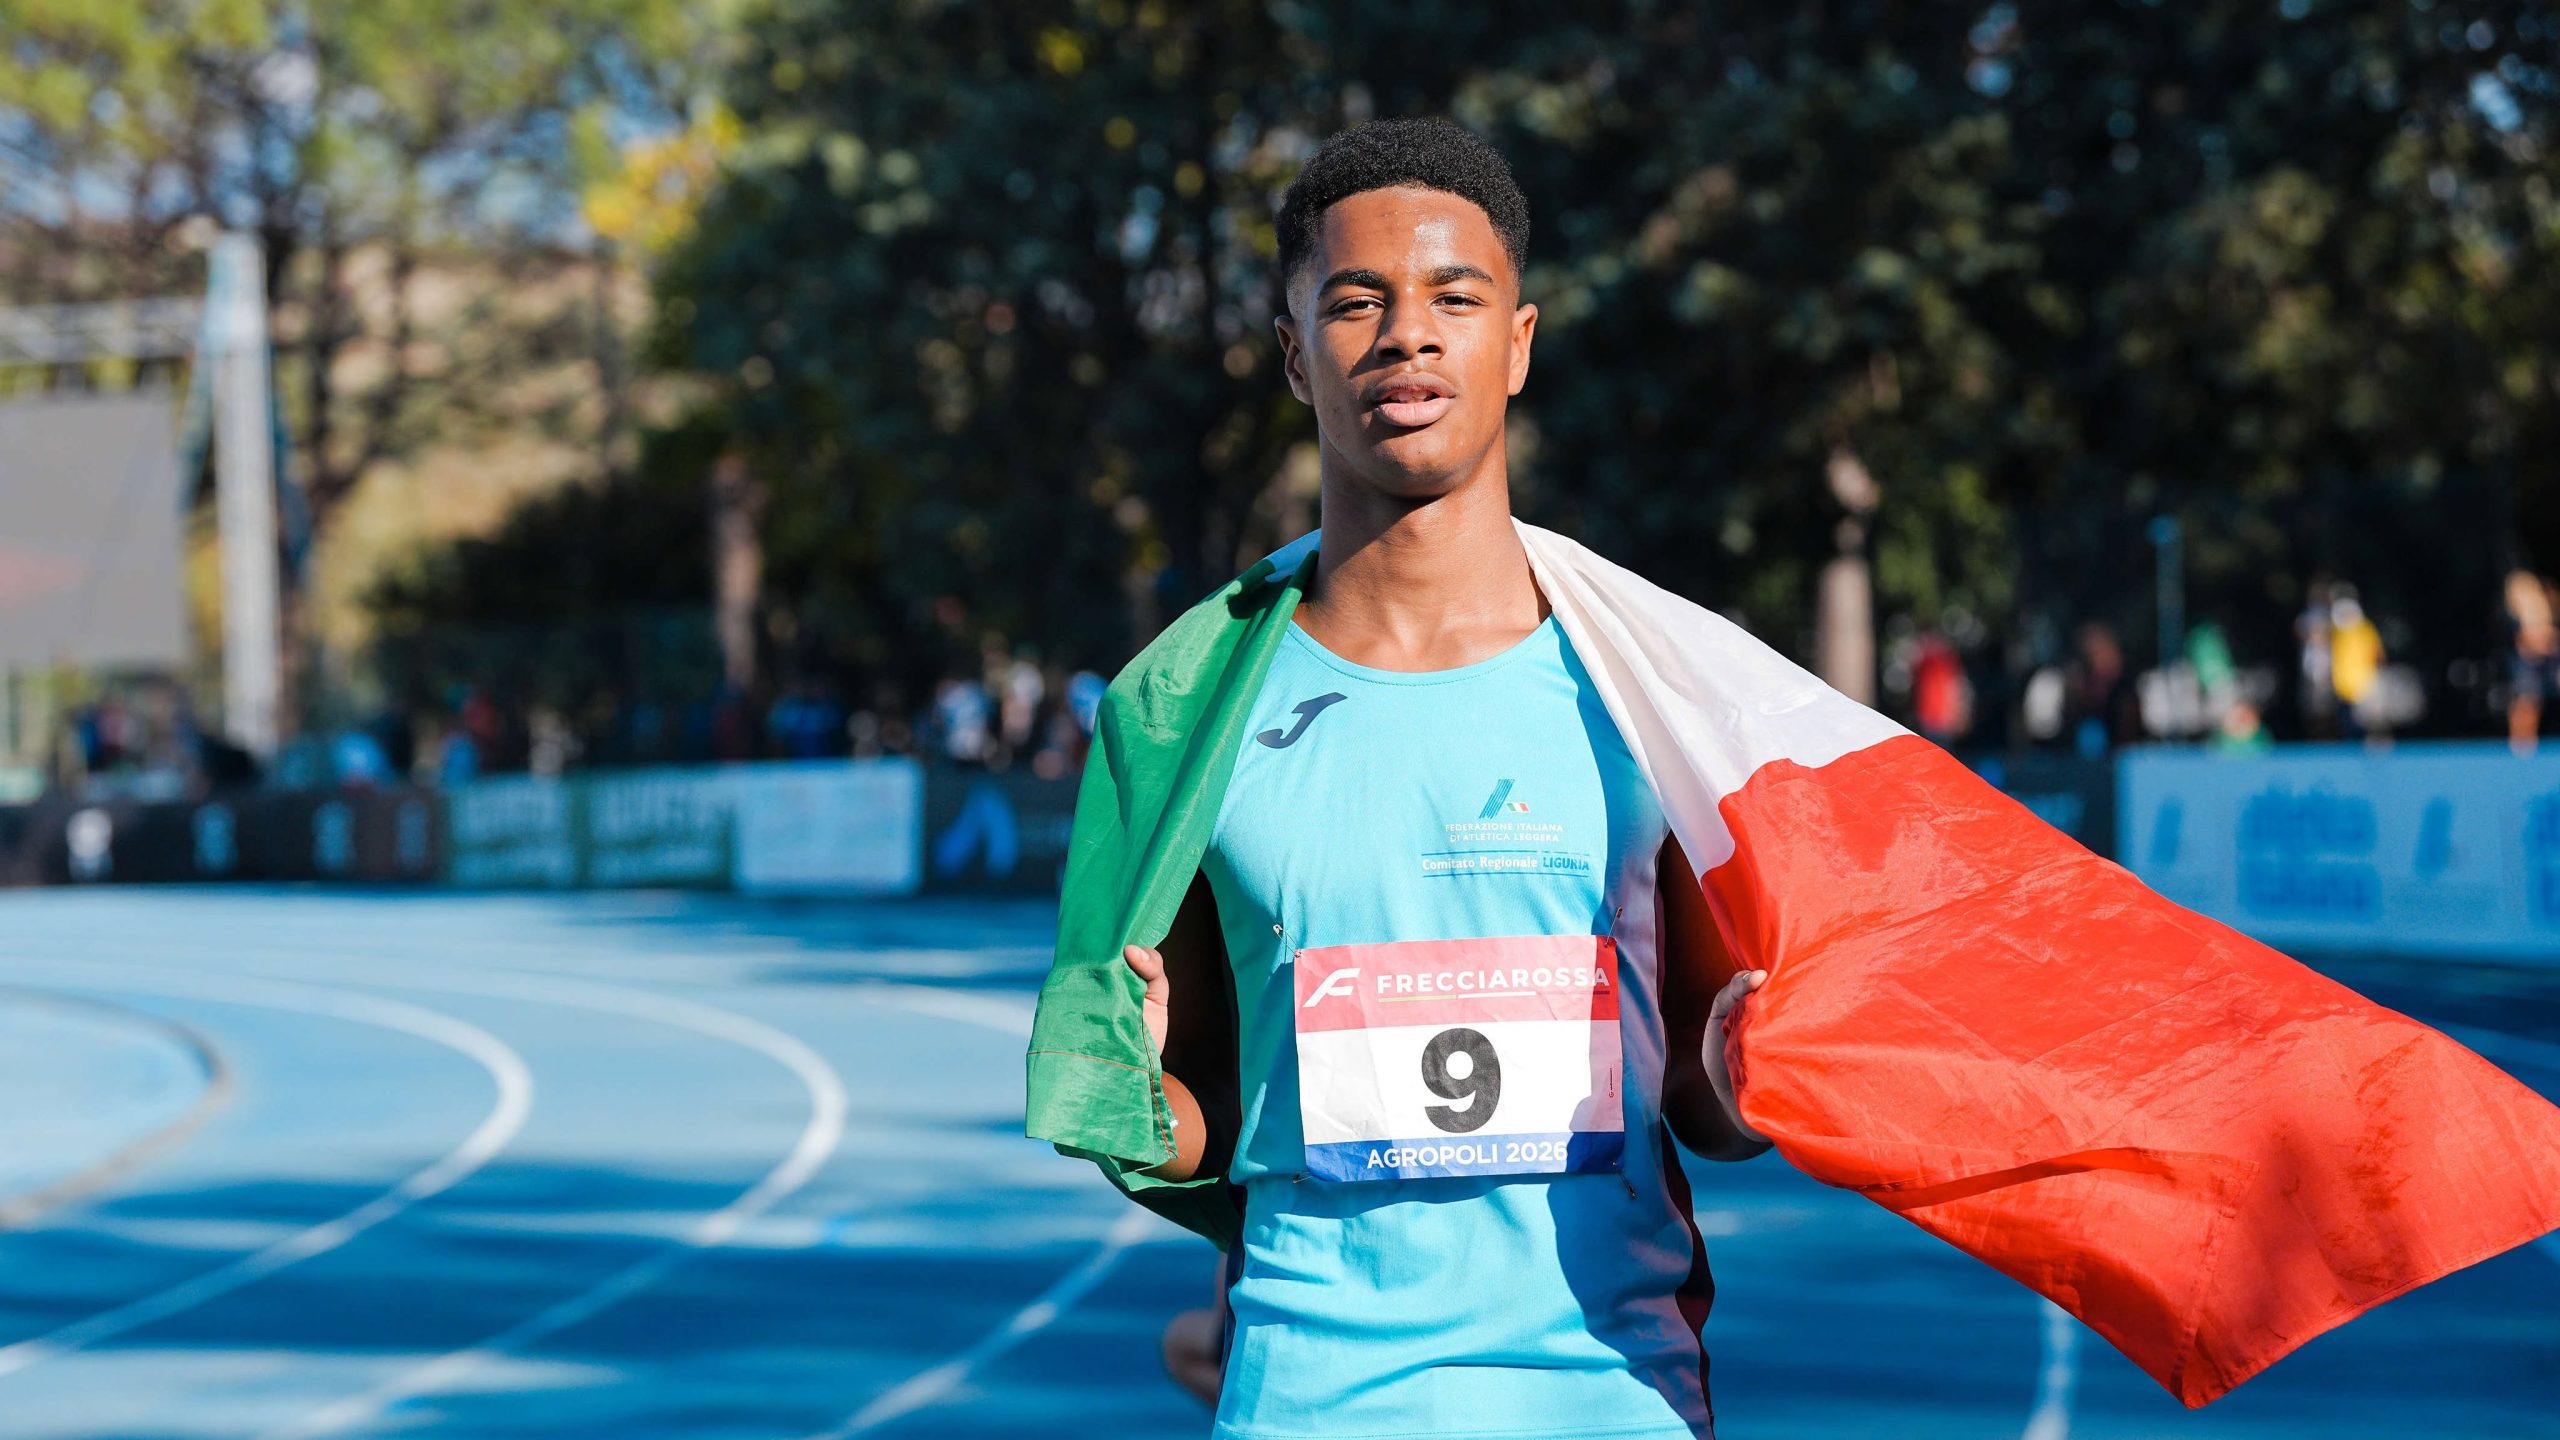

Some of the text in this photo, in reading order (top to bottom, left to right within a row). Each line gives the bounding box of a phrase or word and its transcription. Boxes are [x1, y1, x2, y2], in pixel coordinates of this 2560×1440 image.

[1445, 823, 1563, 833] FEDERAZIONE ITALIANA
[1463, 833, 1511, 842] ATLETICA
[1422, 856, 1590, 871] Comitato Regionale LIGURIA
[1377, 967, 1611, 994] FRECCIAROSSA
[1421, 1027, 1502, 1134] 9
[1367, 1140, 1569, 1169] AGROPOLI 2026
